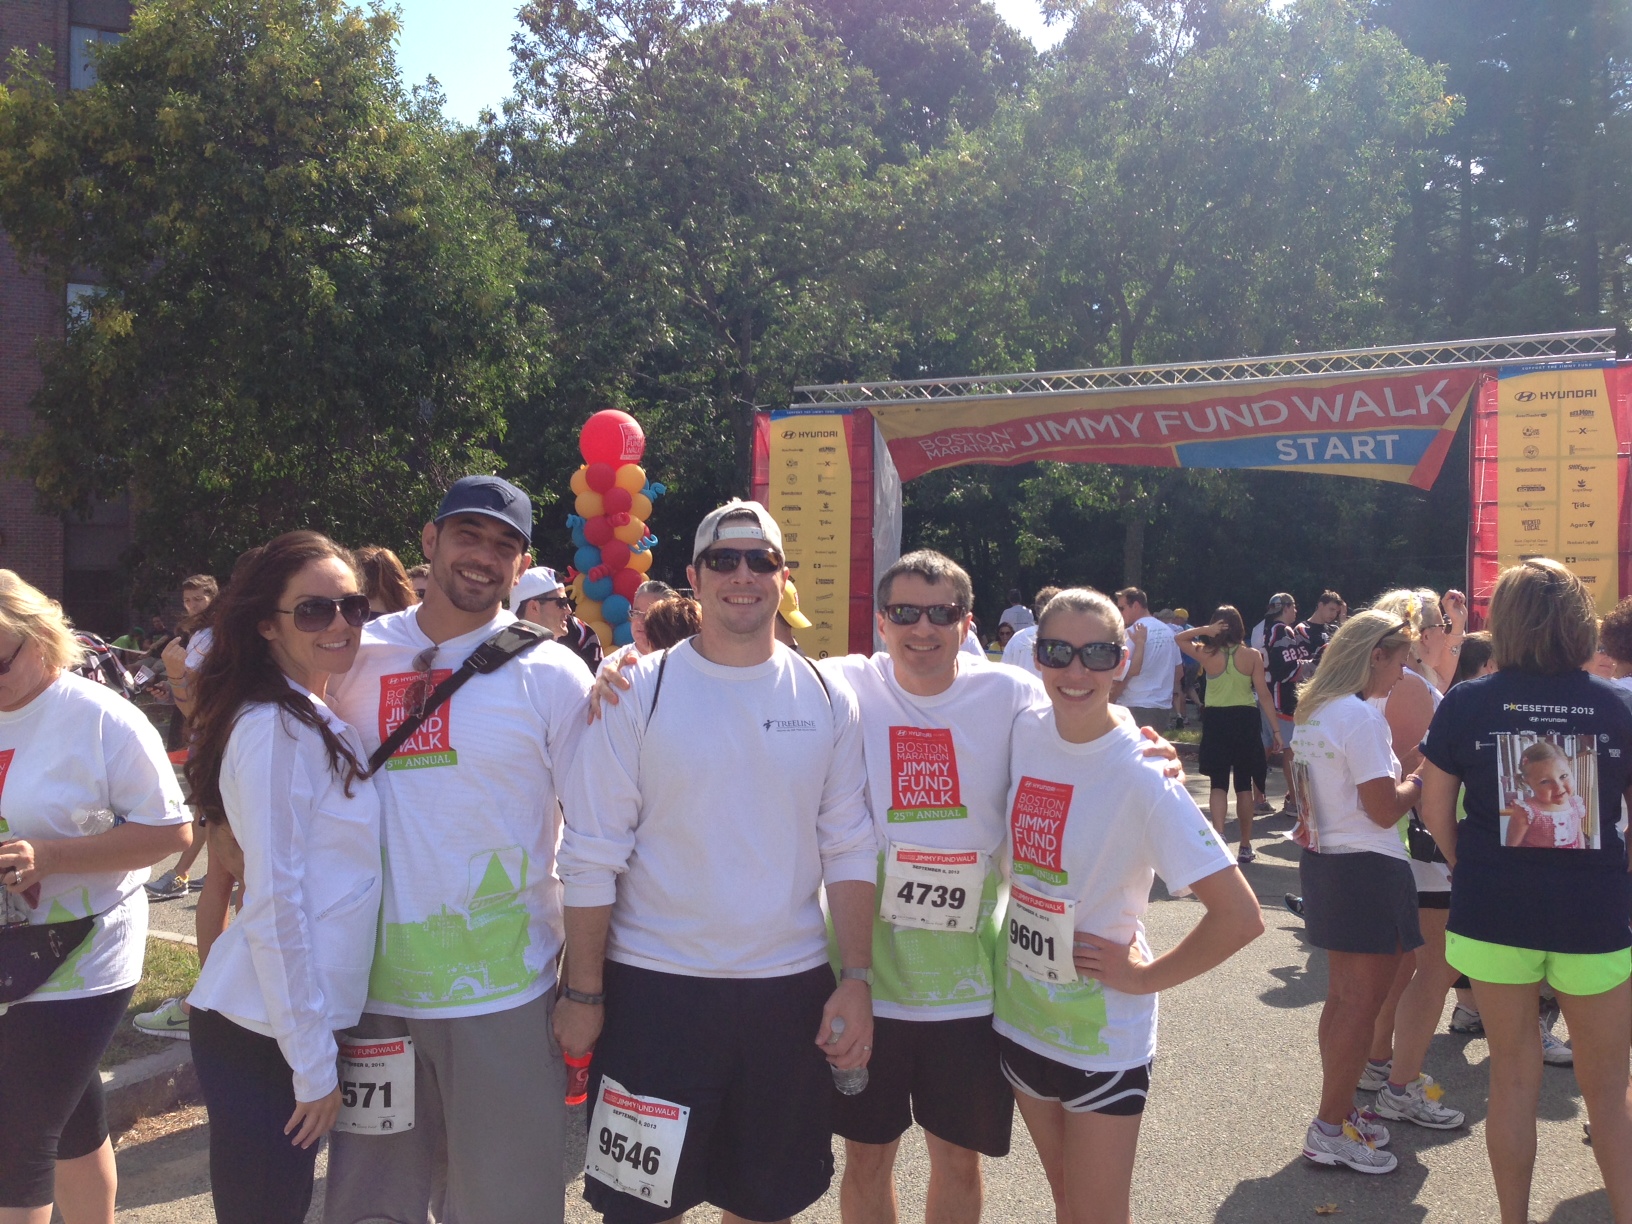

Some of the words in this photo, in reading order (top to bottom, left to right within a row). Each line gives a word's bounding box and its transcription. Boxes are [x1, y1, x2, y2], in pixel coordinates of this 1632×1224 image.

[1540, 389, 1597, 400] HYUNDAI
[1020, 411, 1144, 448] JIMMY
[1153, 399, 1289, 436] FUND
[1290, 378, 1451, 424] WALK
[798, 430, 838, 438] HYUNDAI
[918, 428, 1010, 452] BOSTON
[926, 440, 1016, 461] MARATHON
[1276, 434, 1399, 461] START
[1282, 647, 1298, 662] 22
[1570, 706, 1595, 715] 2013
[896, 741, 949, 754] BOSTON
[405, 754, 451, 768] ANNUAL
[897, 751, 949, 761] MARATHON
[898, 761, 950, 776] JIMMY
[898, 775, 953, 791] FUND
[898, 790, 954, 807] WALK
[1018, 792, 1066, 811] BOSTON
[893, 810, 914, 821] 25TH
[916, 808, 962, 819] ANNUAL
[1016, 802, 1063, 819] MARATHON
[1015, 813, 1061, 834] JIMMY
[1014, 827, 1058, 851] FUND
[915, 854, 937, 862] JIMMY
[937, 855, 956, 863] FUND
[955, 854, 975, 863] WALK
[1016, 843, 1056, 869] WALK
[912, 864, 941, 873] SEPTEMBER
[896, 881, 966, 909] 4739
[1009, 918, 1055, 961] 9601
[357, 1047, 378, 1056] FUND
[378, 1043, 402, 1054] WALK
[616, 1097, 637, 1109] JIMMY
[654, 1106, 677, 1117] WALK
[643, 1121, 657, 1130] 2013
[598, 1126, 661, 1176] 9546
